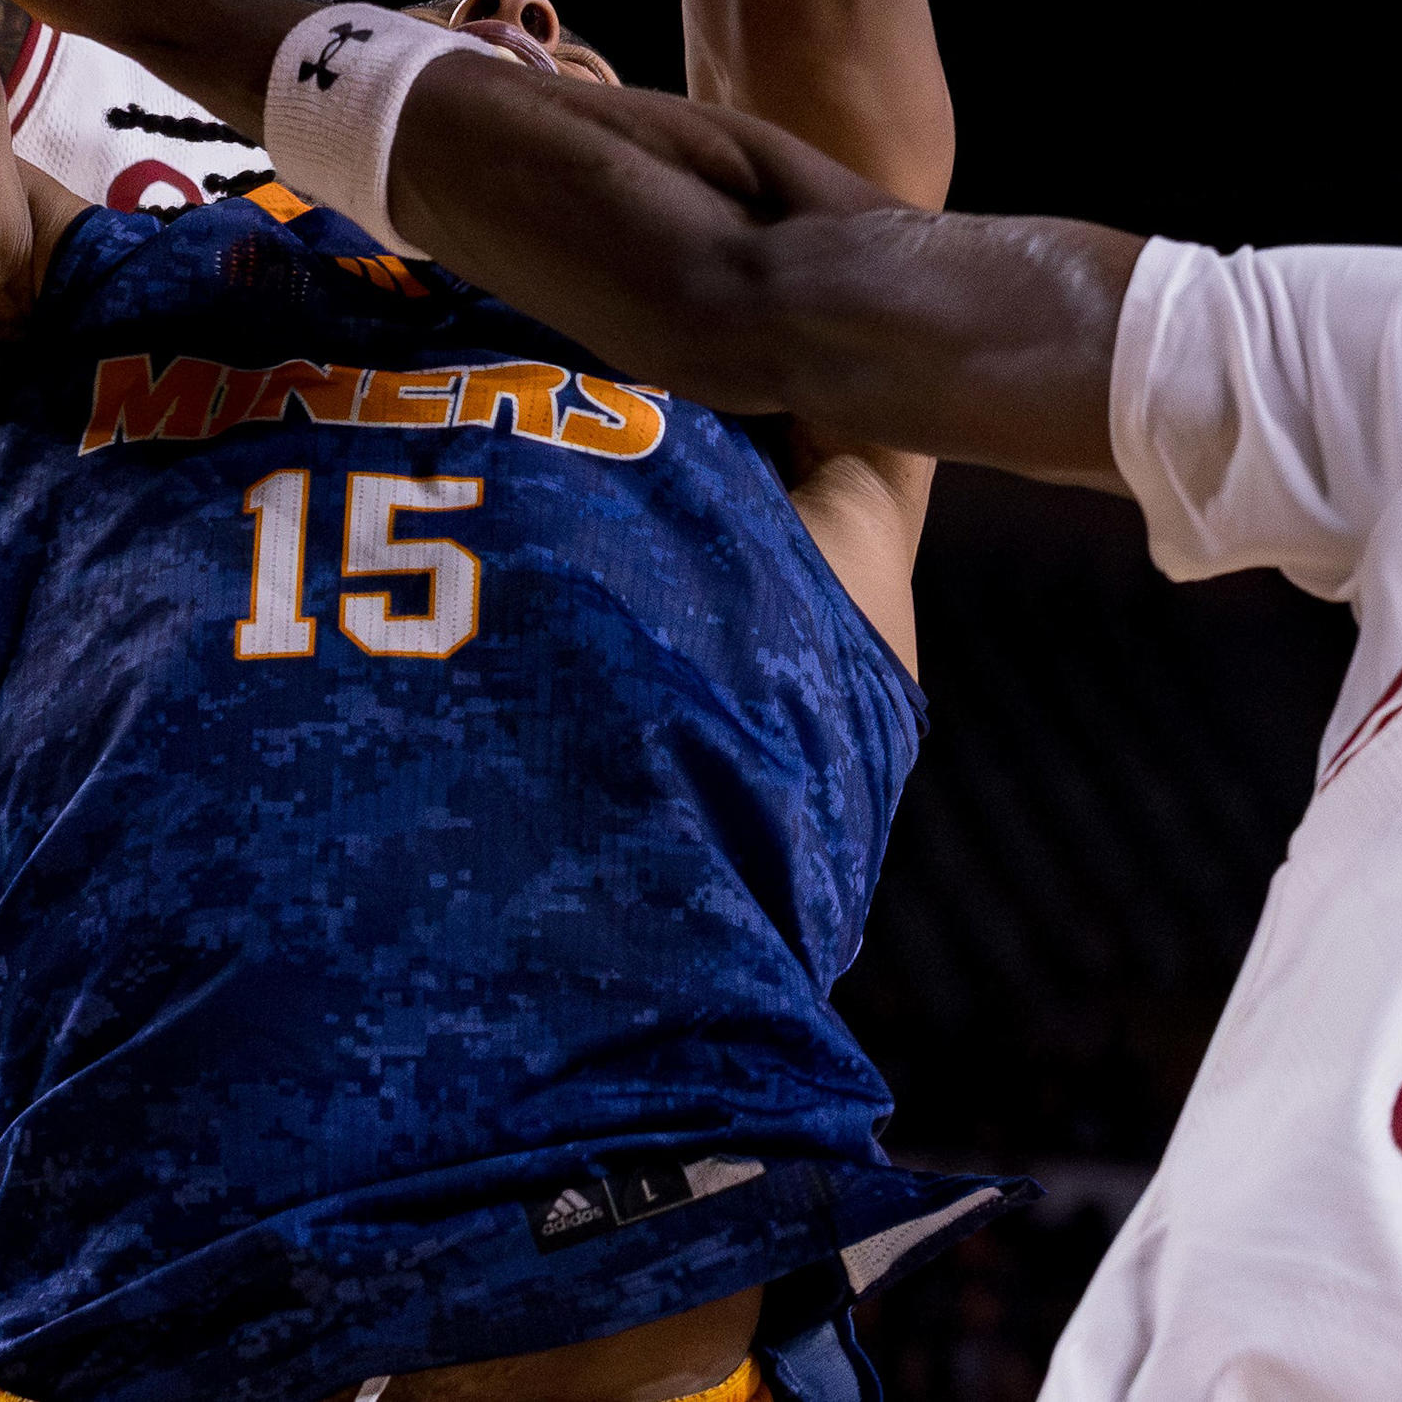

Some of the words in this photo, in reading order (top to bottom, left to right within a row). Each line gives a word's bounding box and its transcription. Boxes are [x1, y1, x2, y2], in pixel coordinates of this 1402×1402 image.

[77, 353, 670, 462] MINERS
[234, 467, 485, 661] 15
[542, 1206, 604, 1235] adidas
[642, 1180, 659, 1202] L
